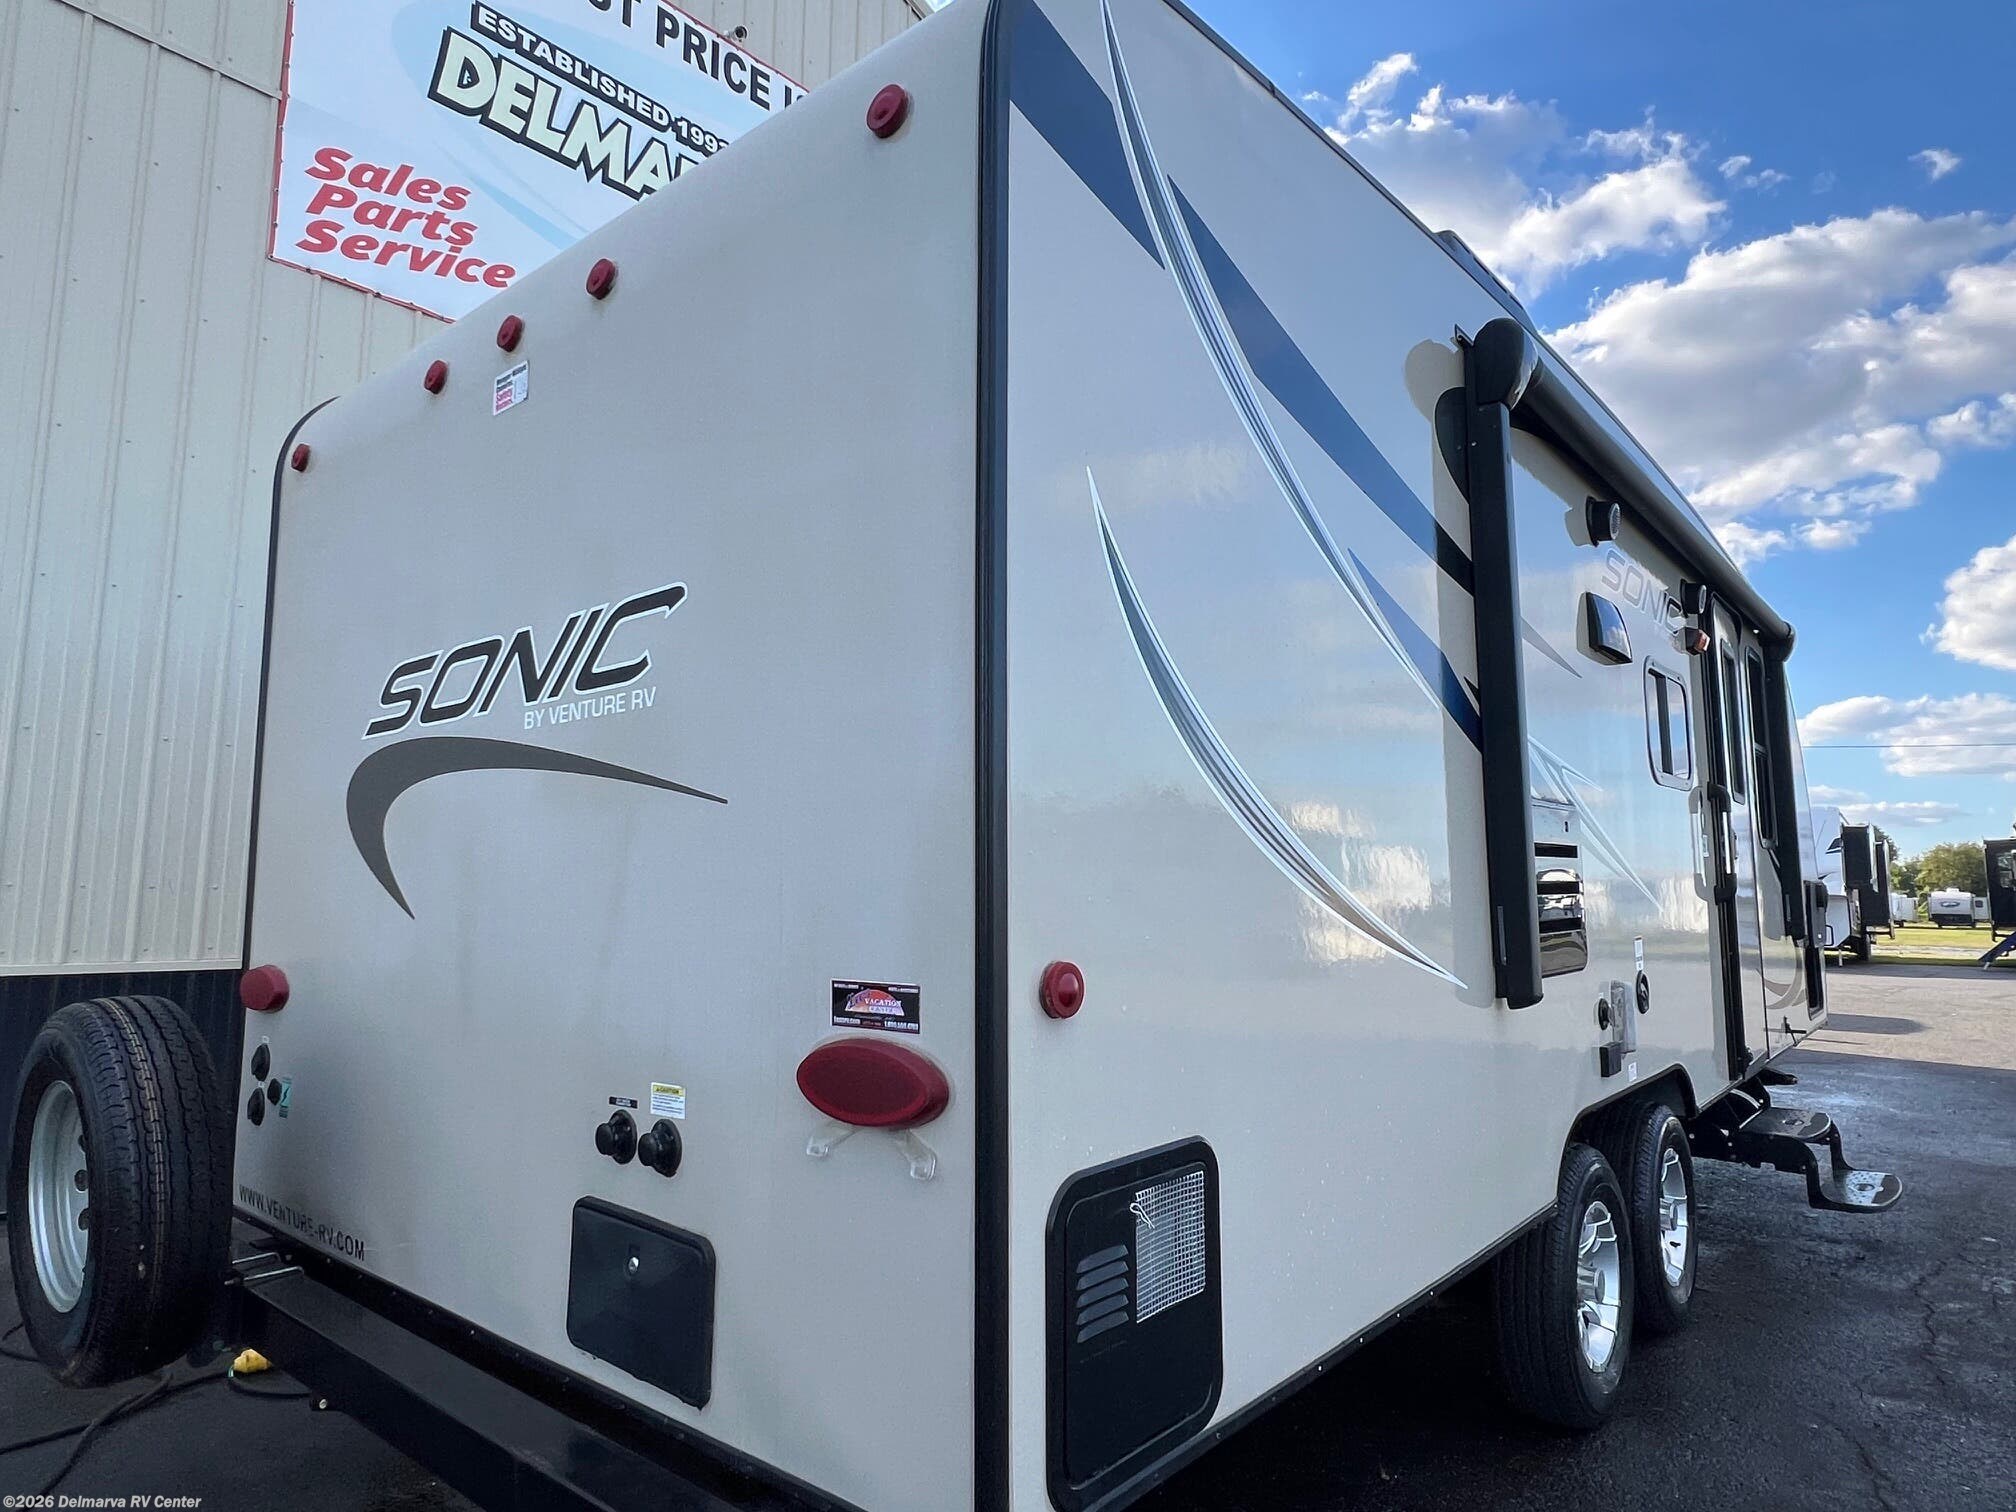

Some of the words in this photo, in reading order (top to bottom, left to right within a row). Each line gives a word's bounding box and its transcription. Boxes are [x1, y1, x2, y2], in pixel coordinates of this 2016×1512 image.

[478, 6, 669, 127] ESTABLISHED
[656, 5, 770, 111] PRICE
[784, 85, 804, 110] I
[304, 147, 472, 211] Sales
[305, 182, 478, 246] Parts
[295, 219, 516, 288] Service
[1601, 547, 1683, 636] SONIC
[361, 582, 688, 739] SONIC
[524, 709, 546, 729] BY
[549, 693, 626, 725] VENTURE
[631, 686, 657, 711] RV
[239, 1184, 365, 1261] WWW.VENTURE-RV.COM
